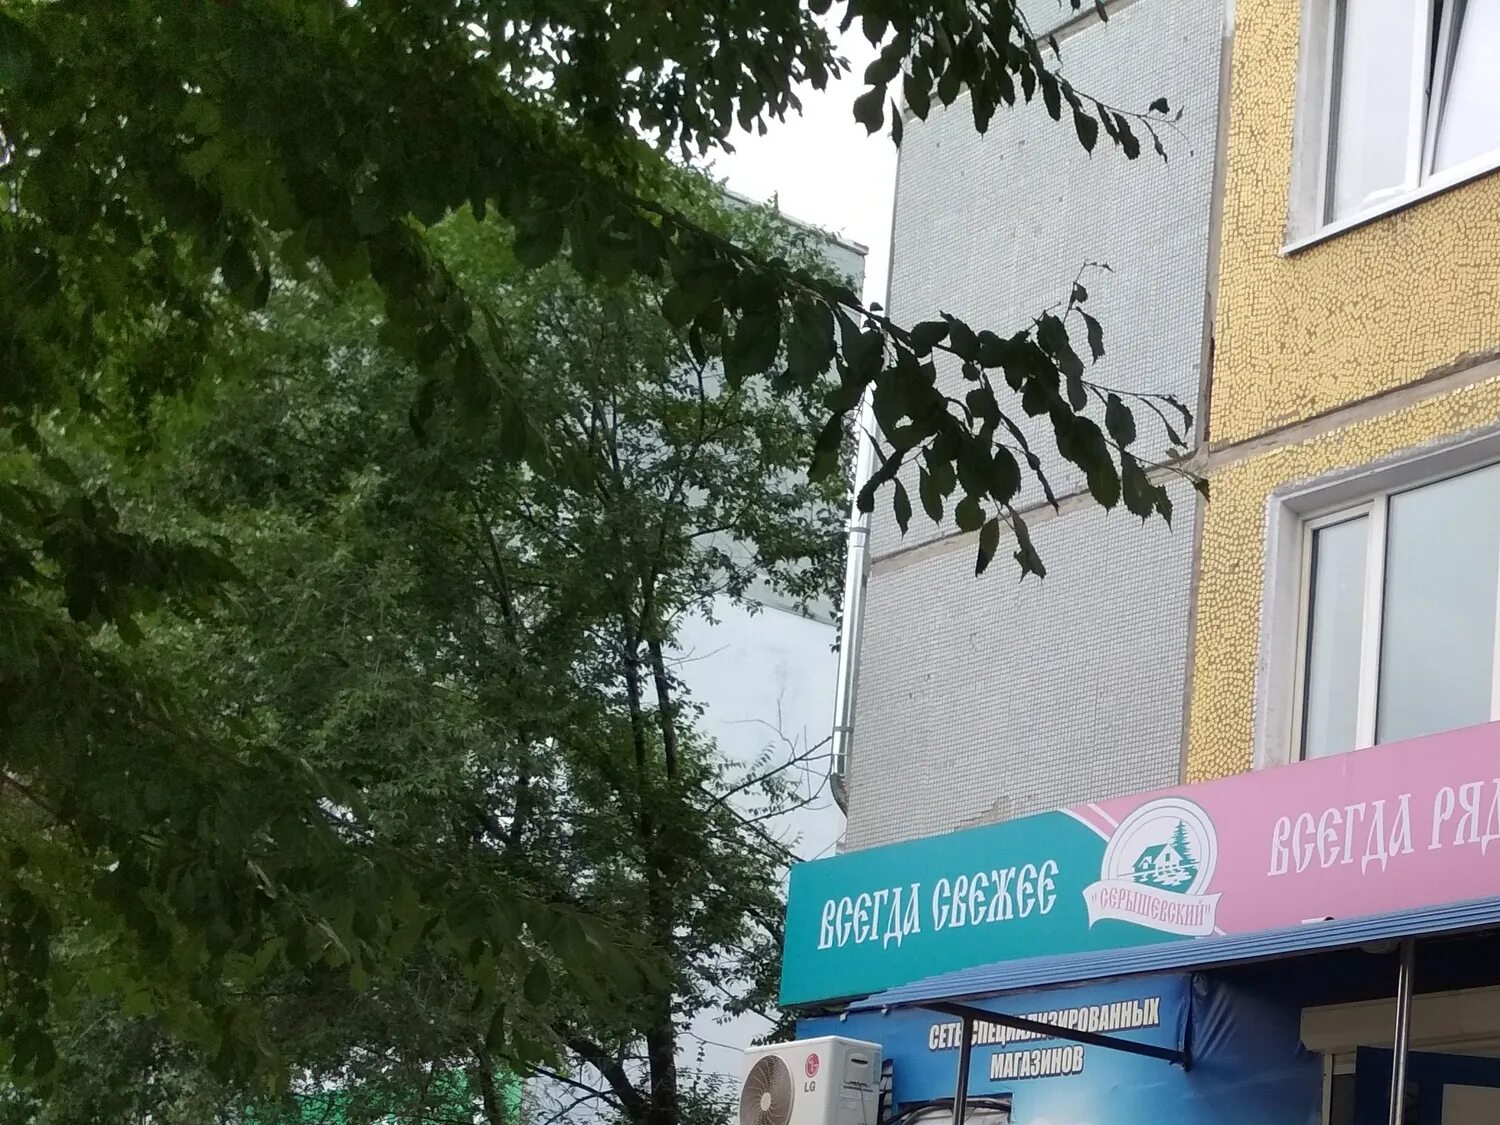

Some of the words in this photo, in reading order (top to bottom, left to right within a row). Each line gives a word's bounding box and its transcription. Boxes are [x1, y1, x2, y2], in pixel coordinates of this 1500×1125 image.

[1267, 793, 1414, 876] ВСЕГДА
[817, 883, 921, 950] ВСЕГДА
[932, 859, 1061, 932] СВЕЖЕЕ
[1091, 886, 1211, 927] "СЕРЫШЕВСКИЙ"
[989, 1045, 1086, 1082] МАГАЗИНОВ
[803, 1080, 816, 1093] LG
